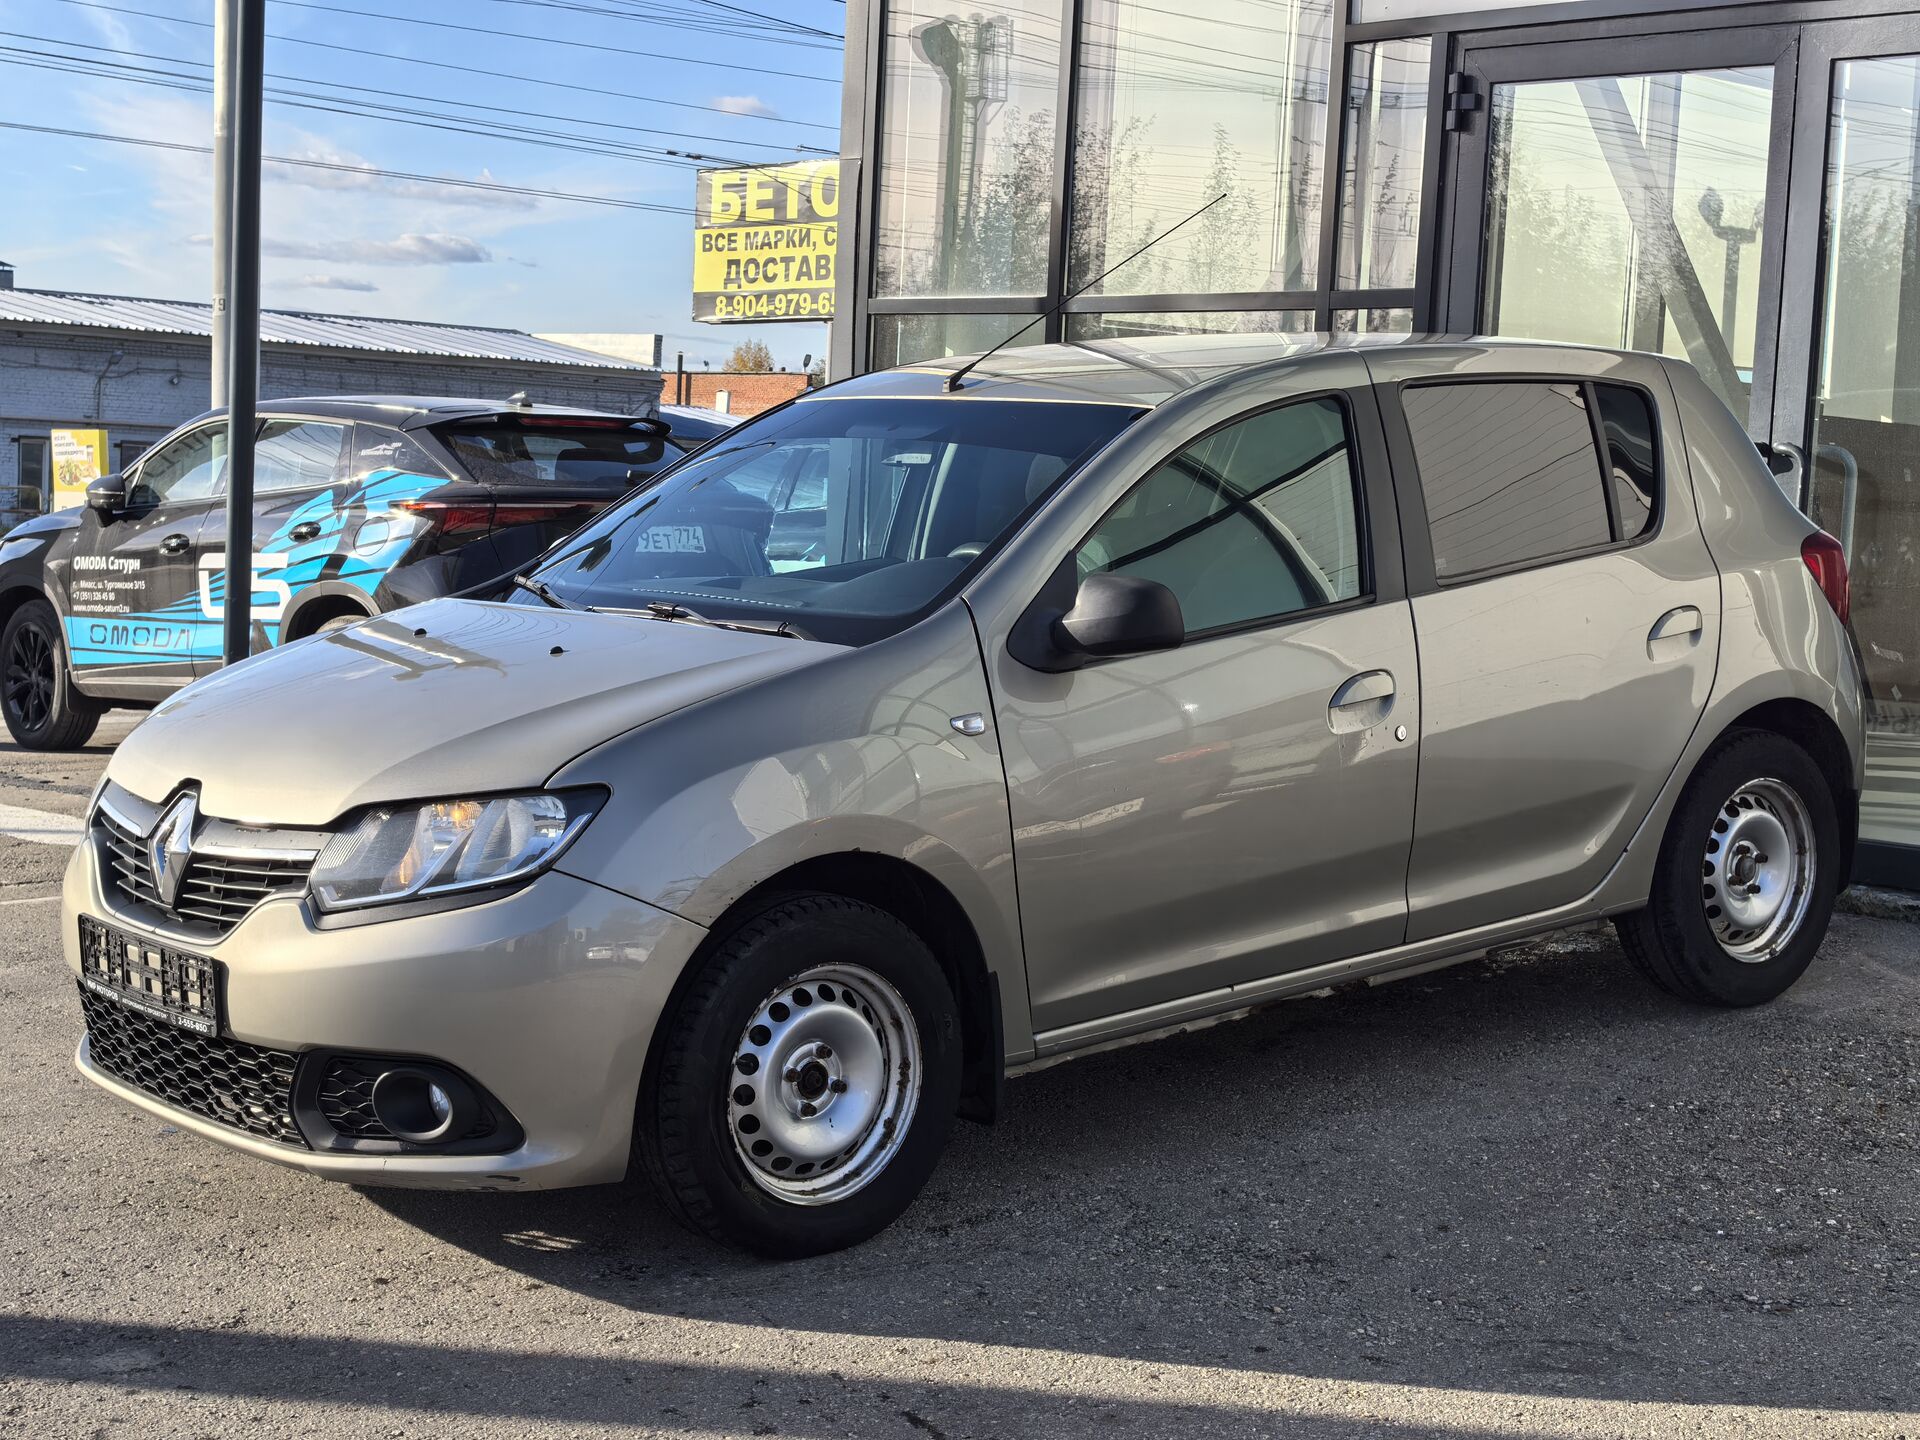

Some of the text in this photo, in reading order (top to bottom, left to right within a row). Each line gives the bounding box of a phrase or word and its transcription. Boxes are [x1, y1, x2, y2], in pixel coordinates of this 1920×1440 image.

[710, 165, 839, 224] БЕТО
[702, 232, 738, 252] ВСЕ
[744, 228, 817, 251] МАРКИ,
[723, 254, 836, 289] ДОСТАВ
[73, 556, 141, 574] OMODA Сатурн
[133, 580, 145, 590] 3/15
[73, 591, 80, 600] +7
[80, 591, 92, 601] (351)
[90, 624, 190, 650] OMODA
[177, 1016, 208, 1033] 2-555-850
